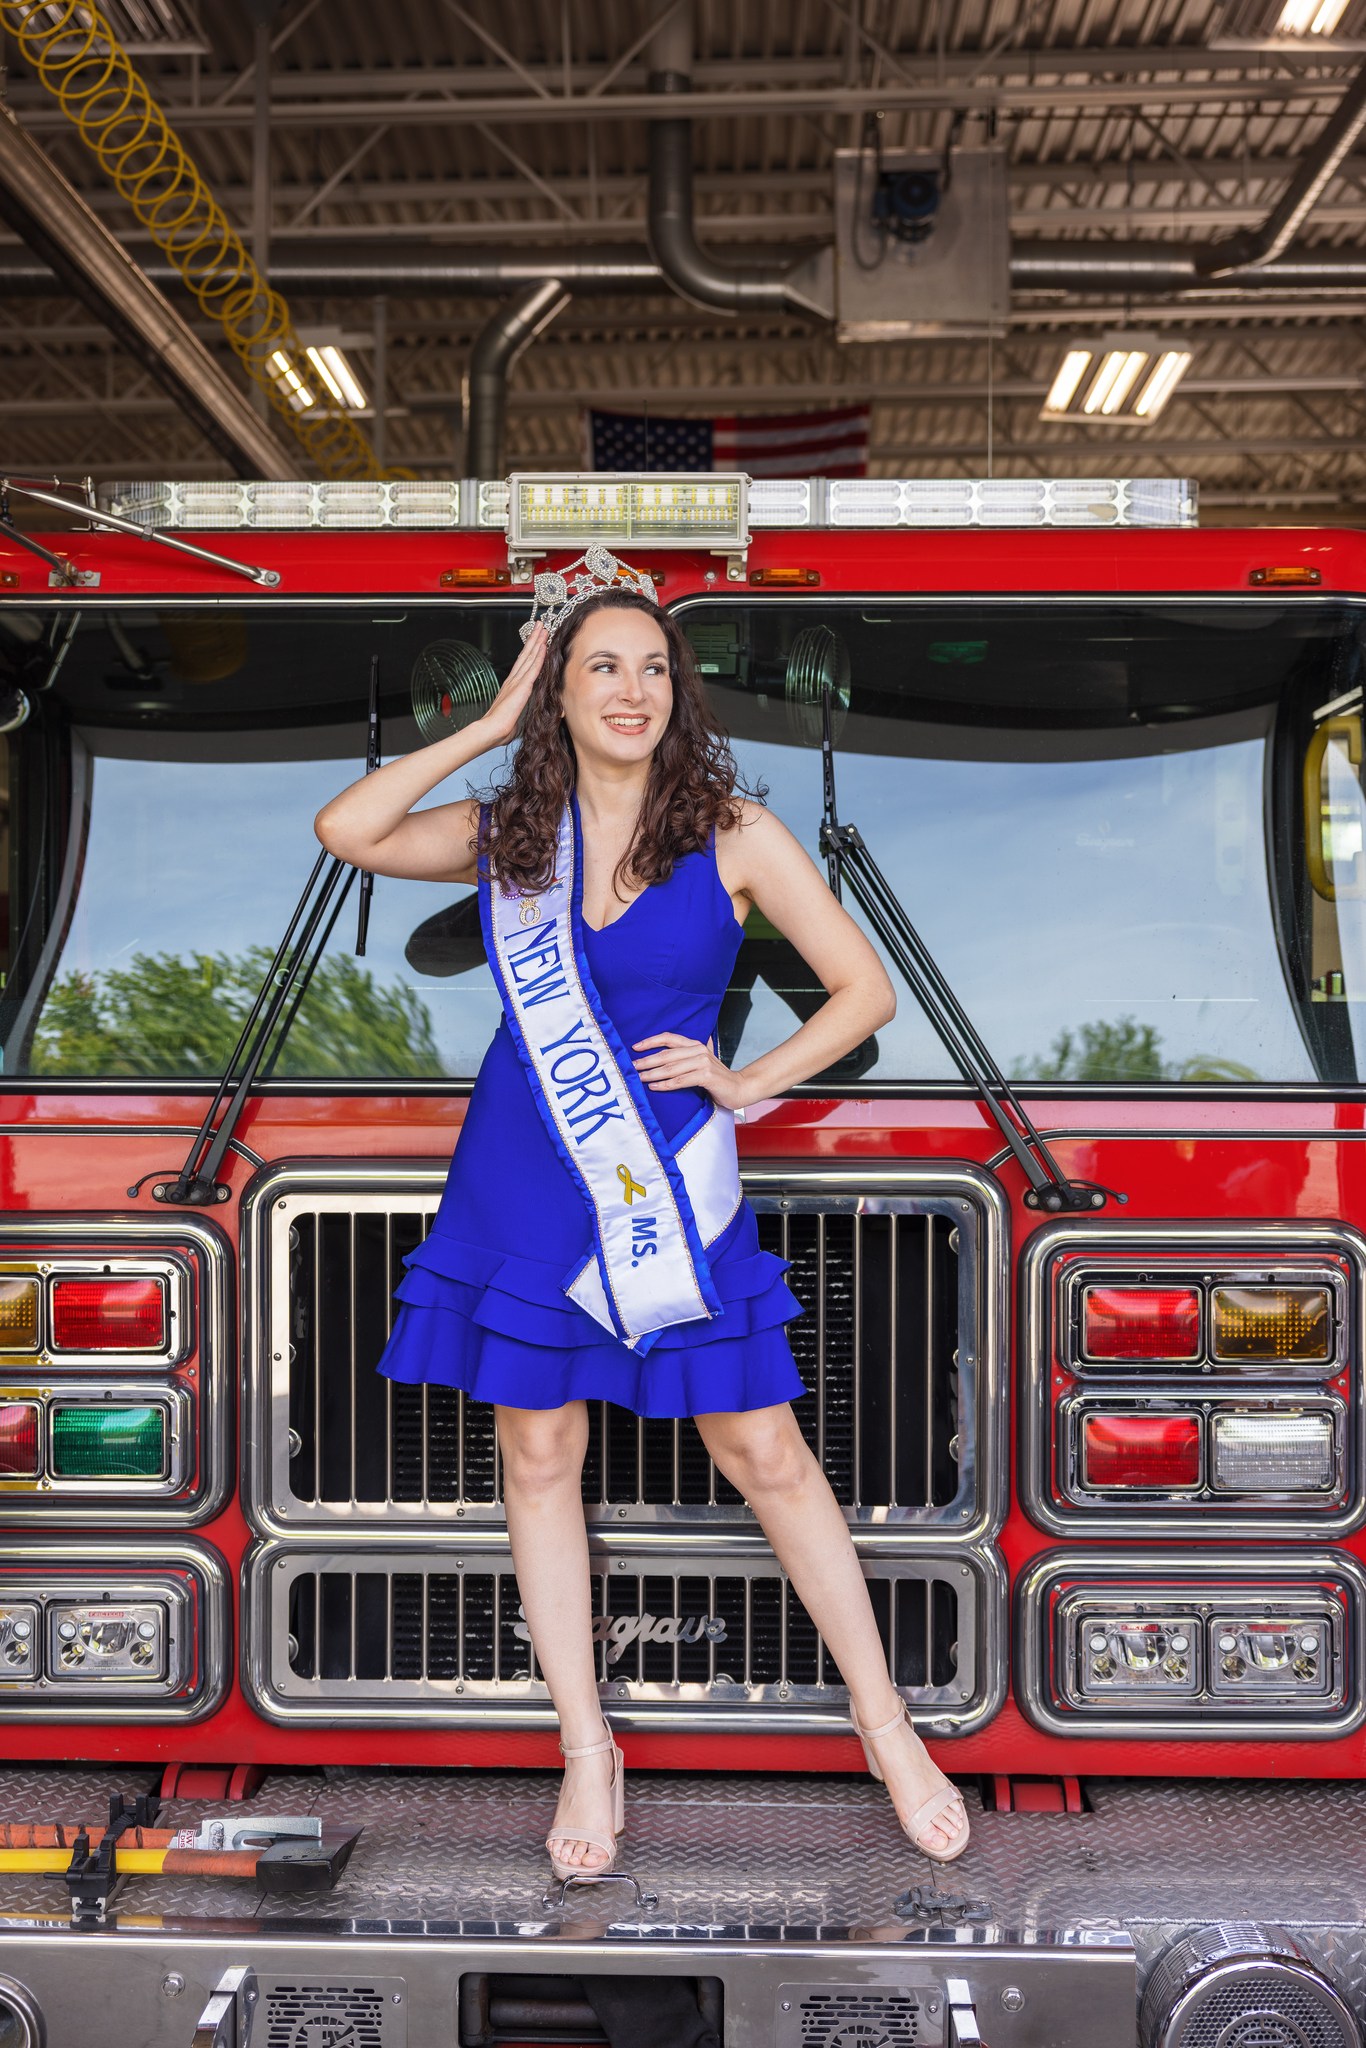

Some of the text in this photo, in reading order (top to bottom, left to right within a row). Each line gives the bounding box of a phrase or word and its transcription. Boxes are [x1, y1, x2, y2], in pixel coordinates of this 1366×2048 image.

[503, 917, 626, 1146] NEW YORK
[631, 1217, 658, 1268] MS.
